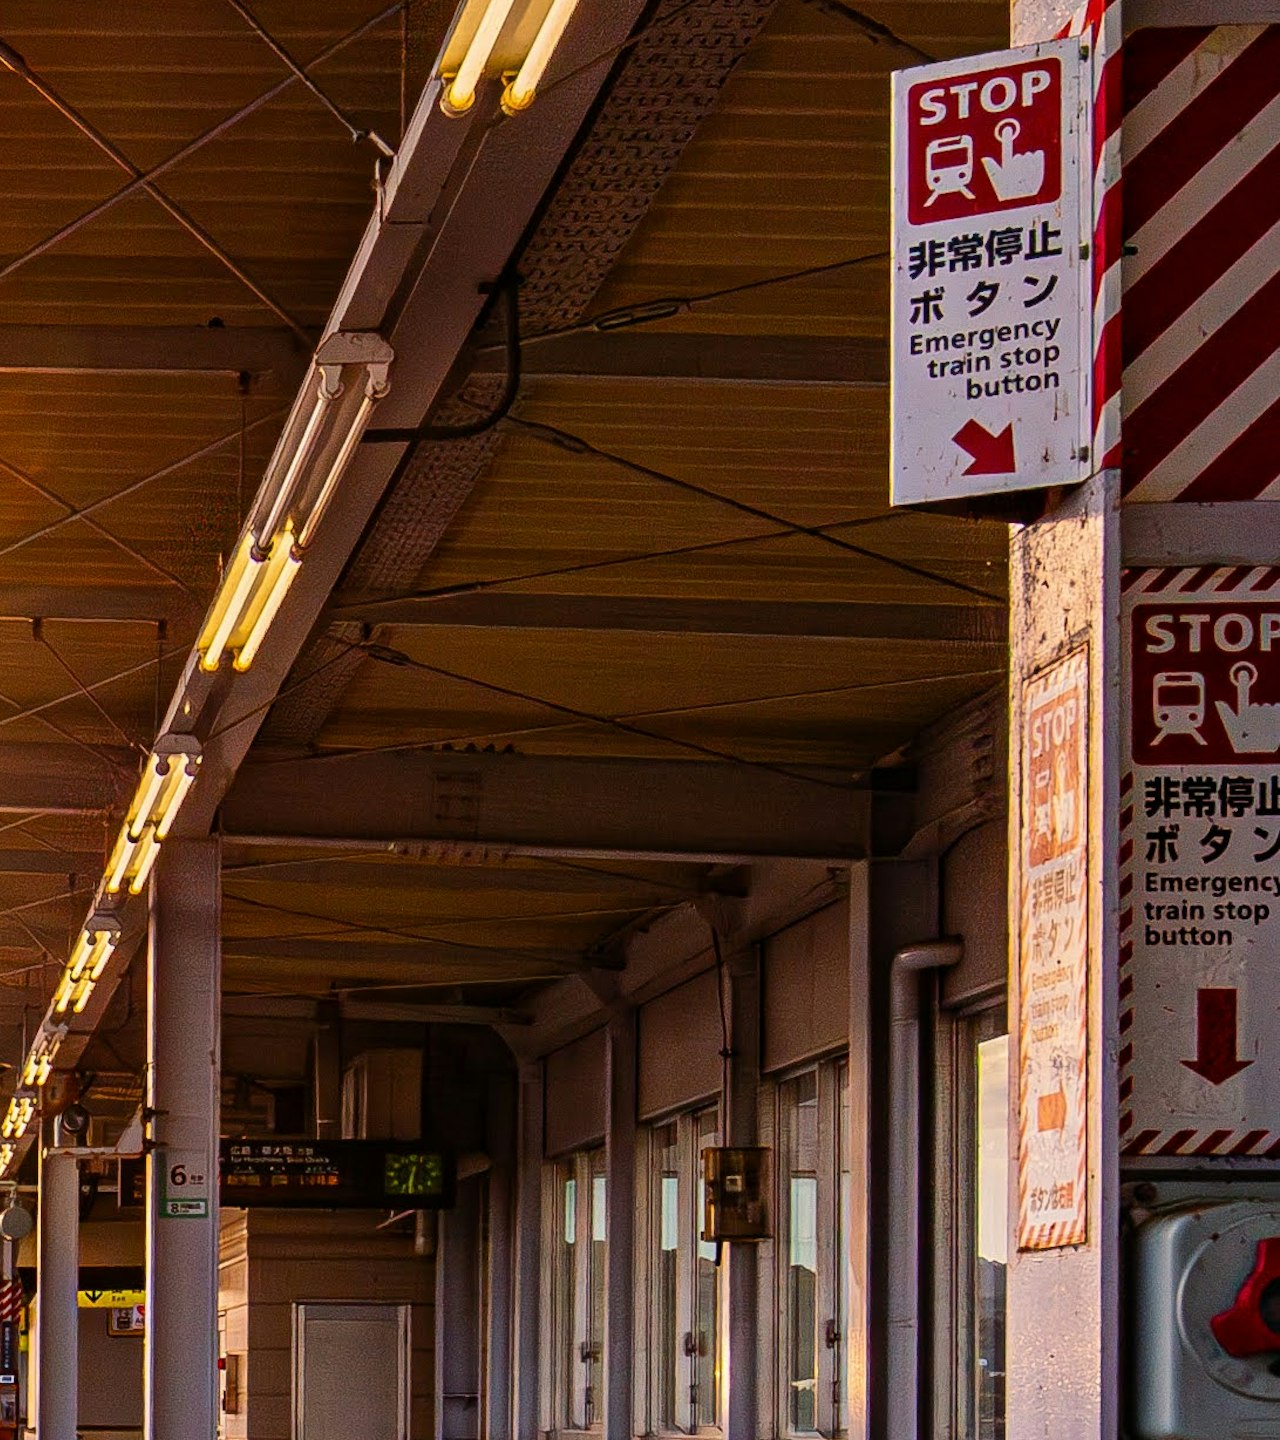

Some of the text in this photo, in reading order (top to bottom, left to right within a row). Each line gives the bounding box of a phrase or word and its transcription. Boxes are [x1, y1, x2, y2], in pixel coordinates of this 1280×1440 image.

[920, 70, 1051, 126] STOP
[909, 221, 1063, 280] 非常停止
[909, 275, 1059, 324] ボタン
[910, 318, 1061, 355] Emergency
[927, 344, 1060, 378] train stop
[966, 371, 1060, 400] button
[1145, 613, 1280, 654] STOP
[1032, 698, 1077, 758] STOP
[1144, 775, 1280, 818] 非常停止
[1145, 823, 1280, 864] ボタン
[1144, 899, 1270, 926] train stop
[1145, 924, 1233, 946] button
[170, 1164, 187, 1186] 6
